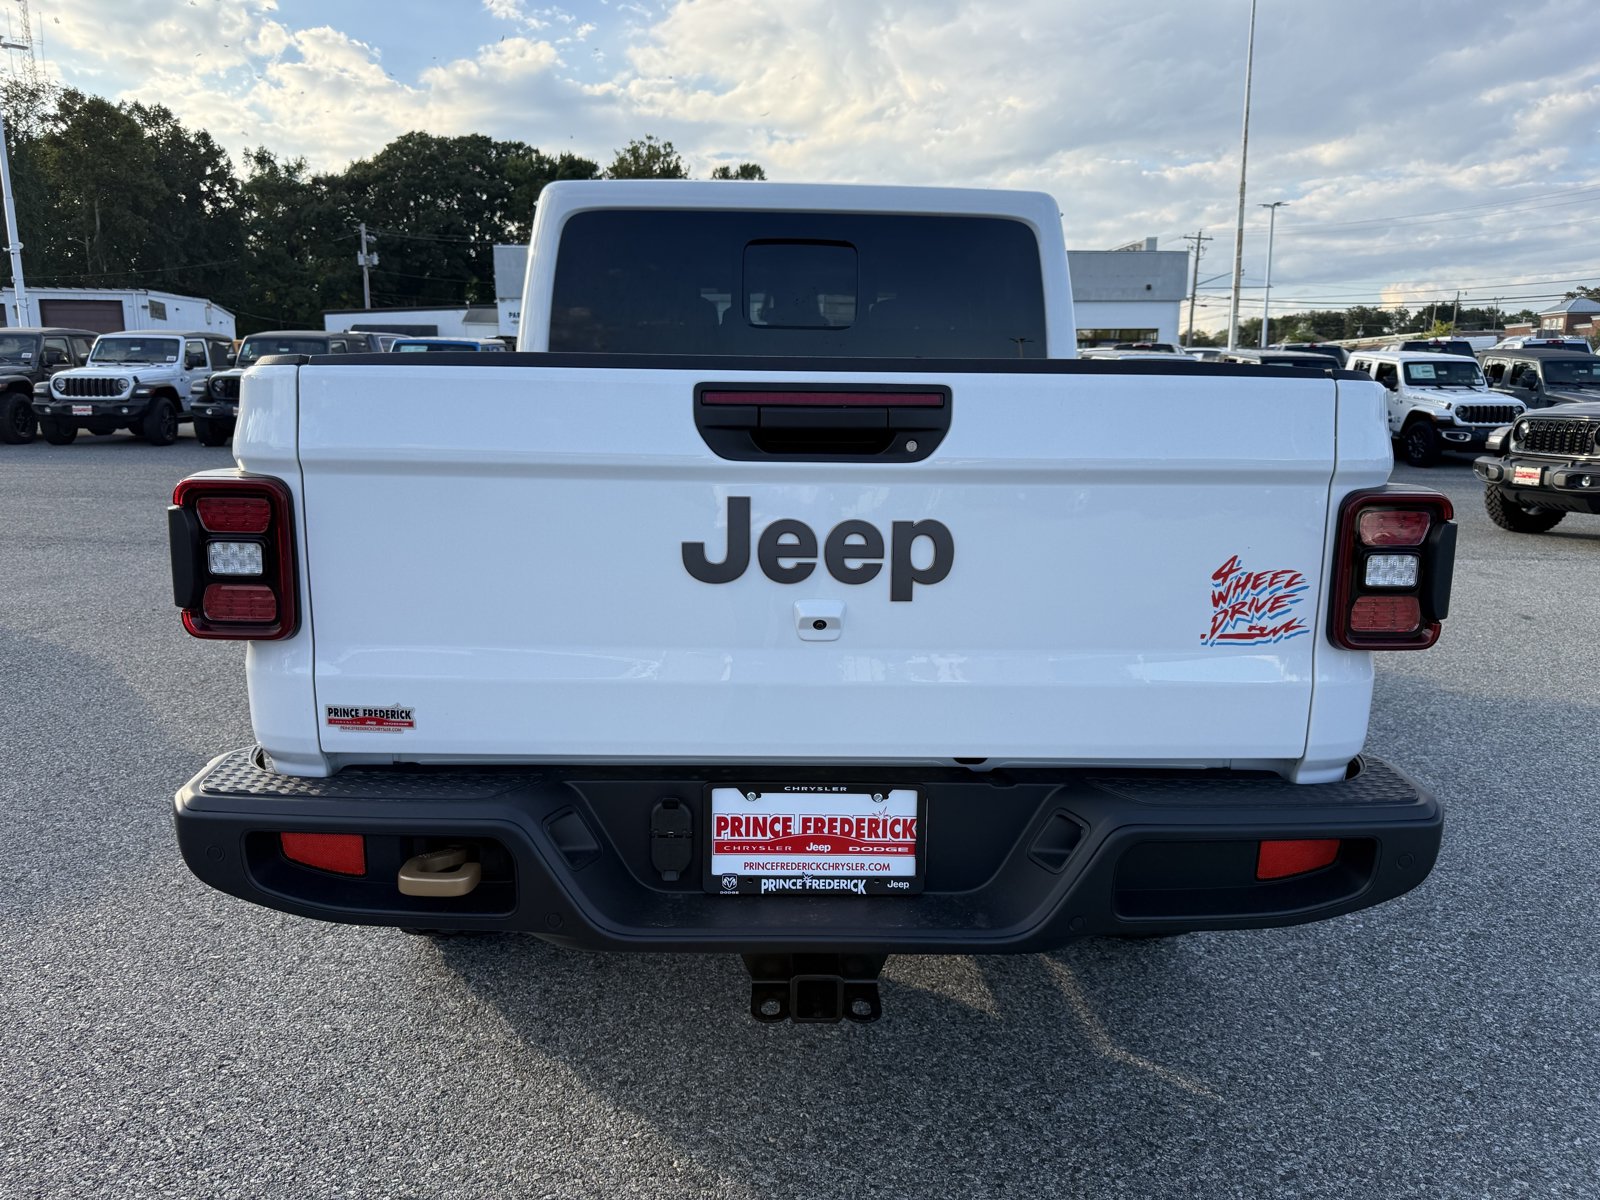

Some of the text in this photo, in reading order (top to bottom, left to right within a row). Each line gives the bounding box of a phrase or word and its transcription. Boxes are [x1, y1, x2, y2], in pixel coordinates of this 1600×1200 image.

[682, 496, 955, 592] Jeep
[1211, 555, 1243, 587] 4
[1211, 569, 1307, 609] WHEEL
[1208, 593, 1298, 641] DRIVE
[327, 707, 412, 720] PRINCE FREDERICK
[716, 816, 917, 840] PRINCE FREDERICK
[805, 842, 831, 853] Jeep
[743, 861, 891, 872] PRINCEFREDERICKCHRYSLER.COM
[761, 878, 867, 894] PRINCE FREDERICK
[887, 879, 910, 889] Jeep
